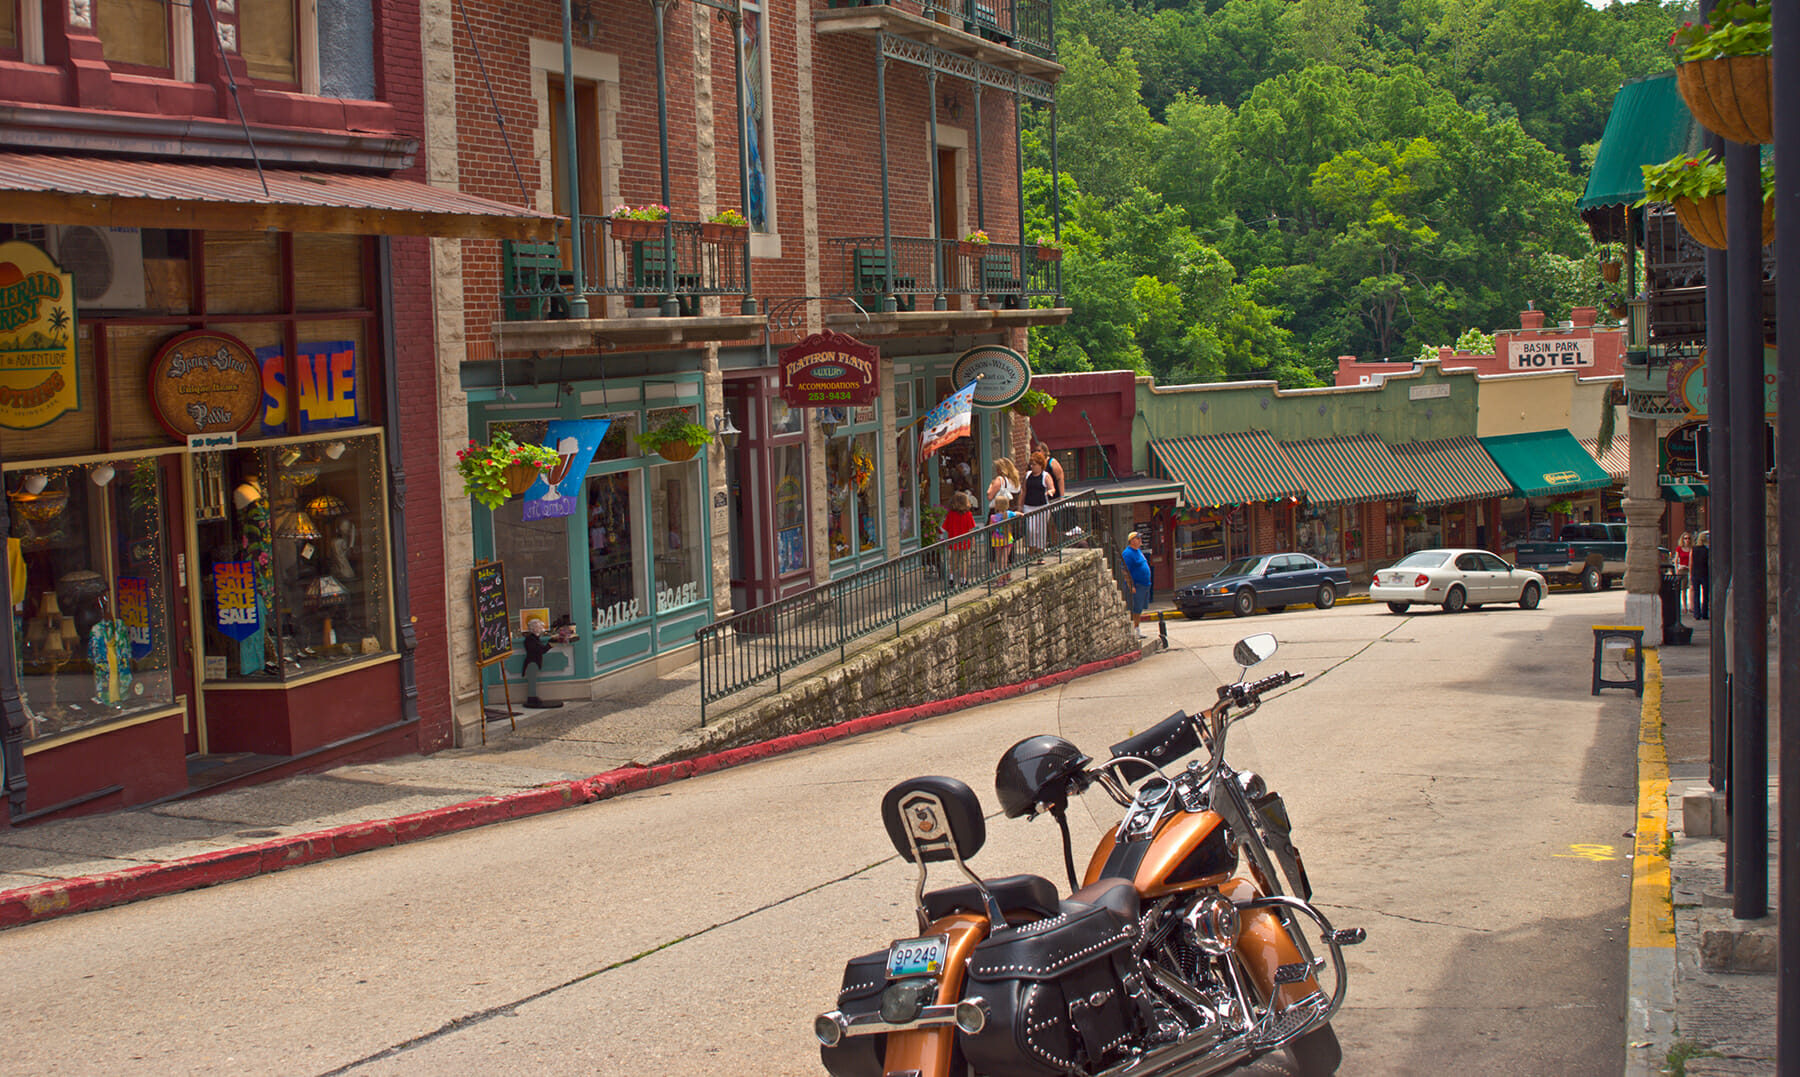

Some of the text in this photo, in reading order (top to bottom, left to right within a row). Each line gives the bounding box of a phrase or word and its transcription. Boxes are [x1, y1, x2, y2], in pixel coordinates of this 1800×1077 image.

[1523, 341, 1580, 353] BASIN PARK
[16, 352, 67, 366] ADVENTURE
[167, 345, 248, 379] Spring Street
[1518, 352, 1588, 368] HOTEL
[785, 351, 872, 387] FLATIRON FLATS
[813, 367, 843, 377] LUXURY
[964, 360, 988, 378] WILSON
[992, 359, 1016, 379] WILSON
[262, 350, 355, 426] SALE
[798, 381, 860, 391] ACCOMMODATIONS
[214, 561, 253, 578] SALE
[118, 578, 147, 593] SALE
[215, 576, 254, 593] SALE
[119, 592, 148, 610] SALE
[217, 592, 256, 609] SALE
[597, 581, 697, 630] DAILY ROAST
[120, 608, 149, 628] SALE
[218, 607, 257, 625] SALE
[130, 626, 151, 644] ALE
[895, 946, 937, 965] 9P 249
